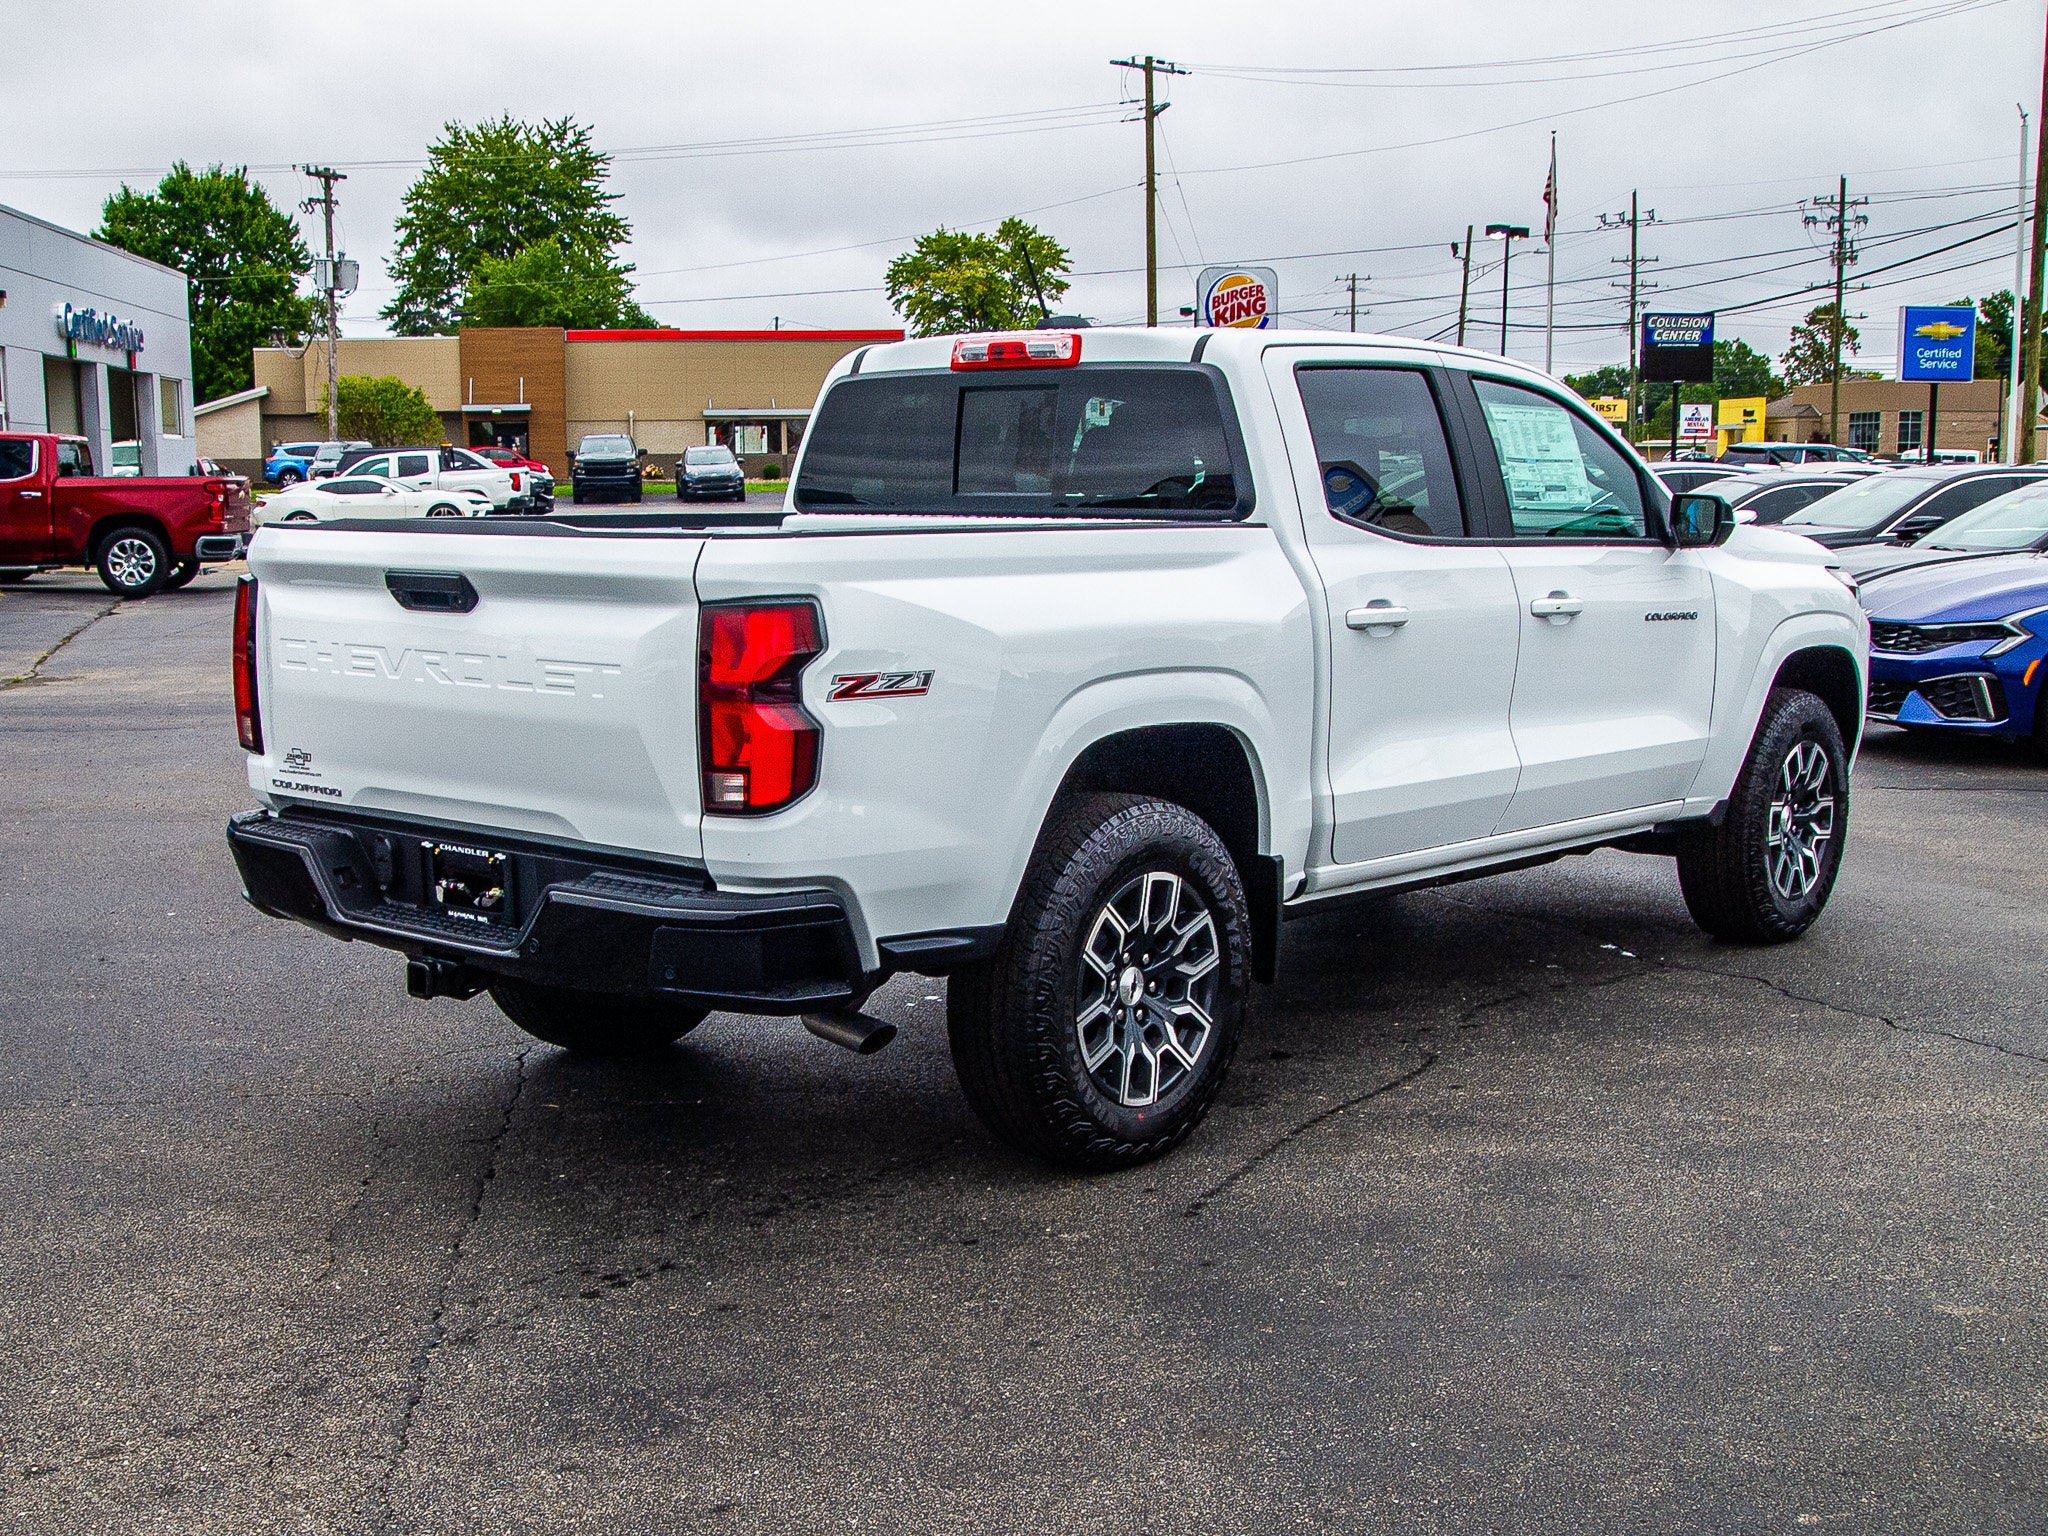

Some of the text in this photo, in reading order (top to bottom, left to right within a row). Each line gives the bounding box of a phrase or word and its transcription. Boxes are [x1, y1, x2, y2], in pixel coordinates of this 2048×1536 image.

[1212, 284, 1264, 310] BURGER
[1214, 296, 1266, 327] KING
[62, 302, 144, 352] Certified Service
[1648, 316, 1710, 328] COLLISION
[1653, 328, 1702, 341] CENTER
[1916, 347, 1962, 358] Certified
[1919, 358, 1958, 369] Service
[1644, 611, 1698, 621] COLORADO
[279, 637, 622, 699] CHEVROLET
[826, 669, 935, 702] Z71
[439, 844, 489, 858] CHANDLER
